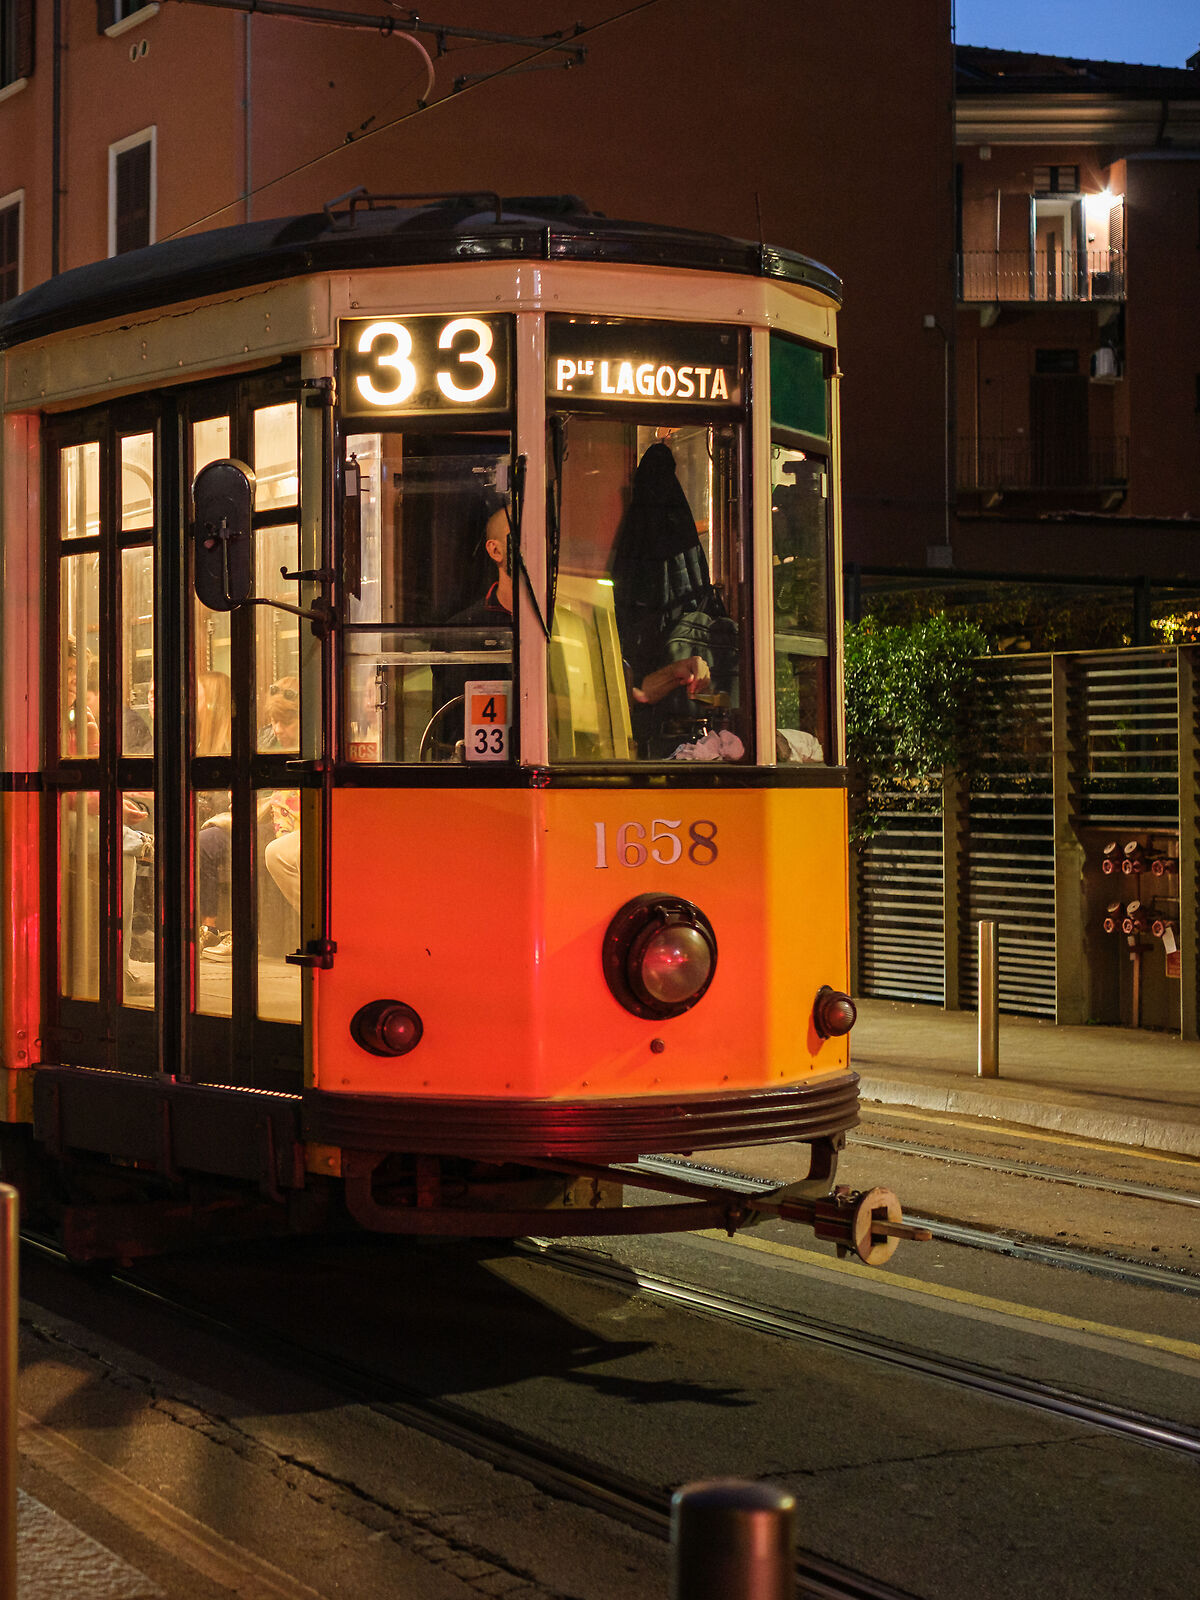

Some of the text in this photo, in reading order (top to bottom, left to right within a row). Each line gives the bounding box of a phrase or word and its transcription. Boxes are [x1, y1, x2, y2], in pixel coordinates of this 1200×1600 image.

[601, 362, 728, 400] LAGOSTA
[482, 697, 497, 723] 4
[474, 728, 504, 754] 33
[594, 818, 719, 869] 1658
